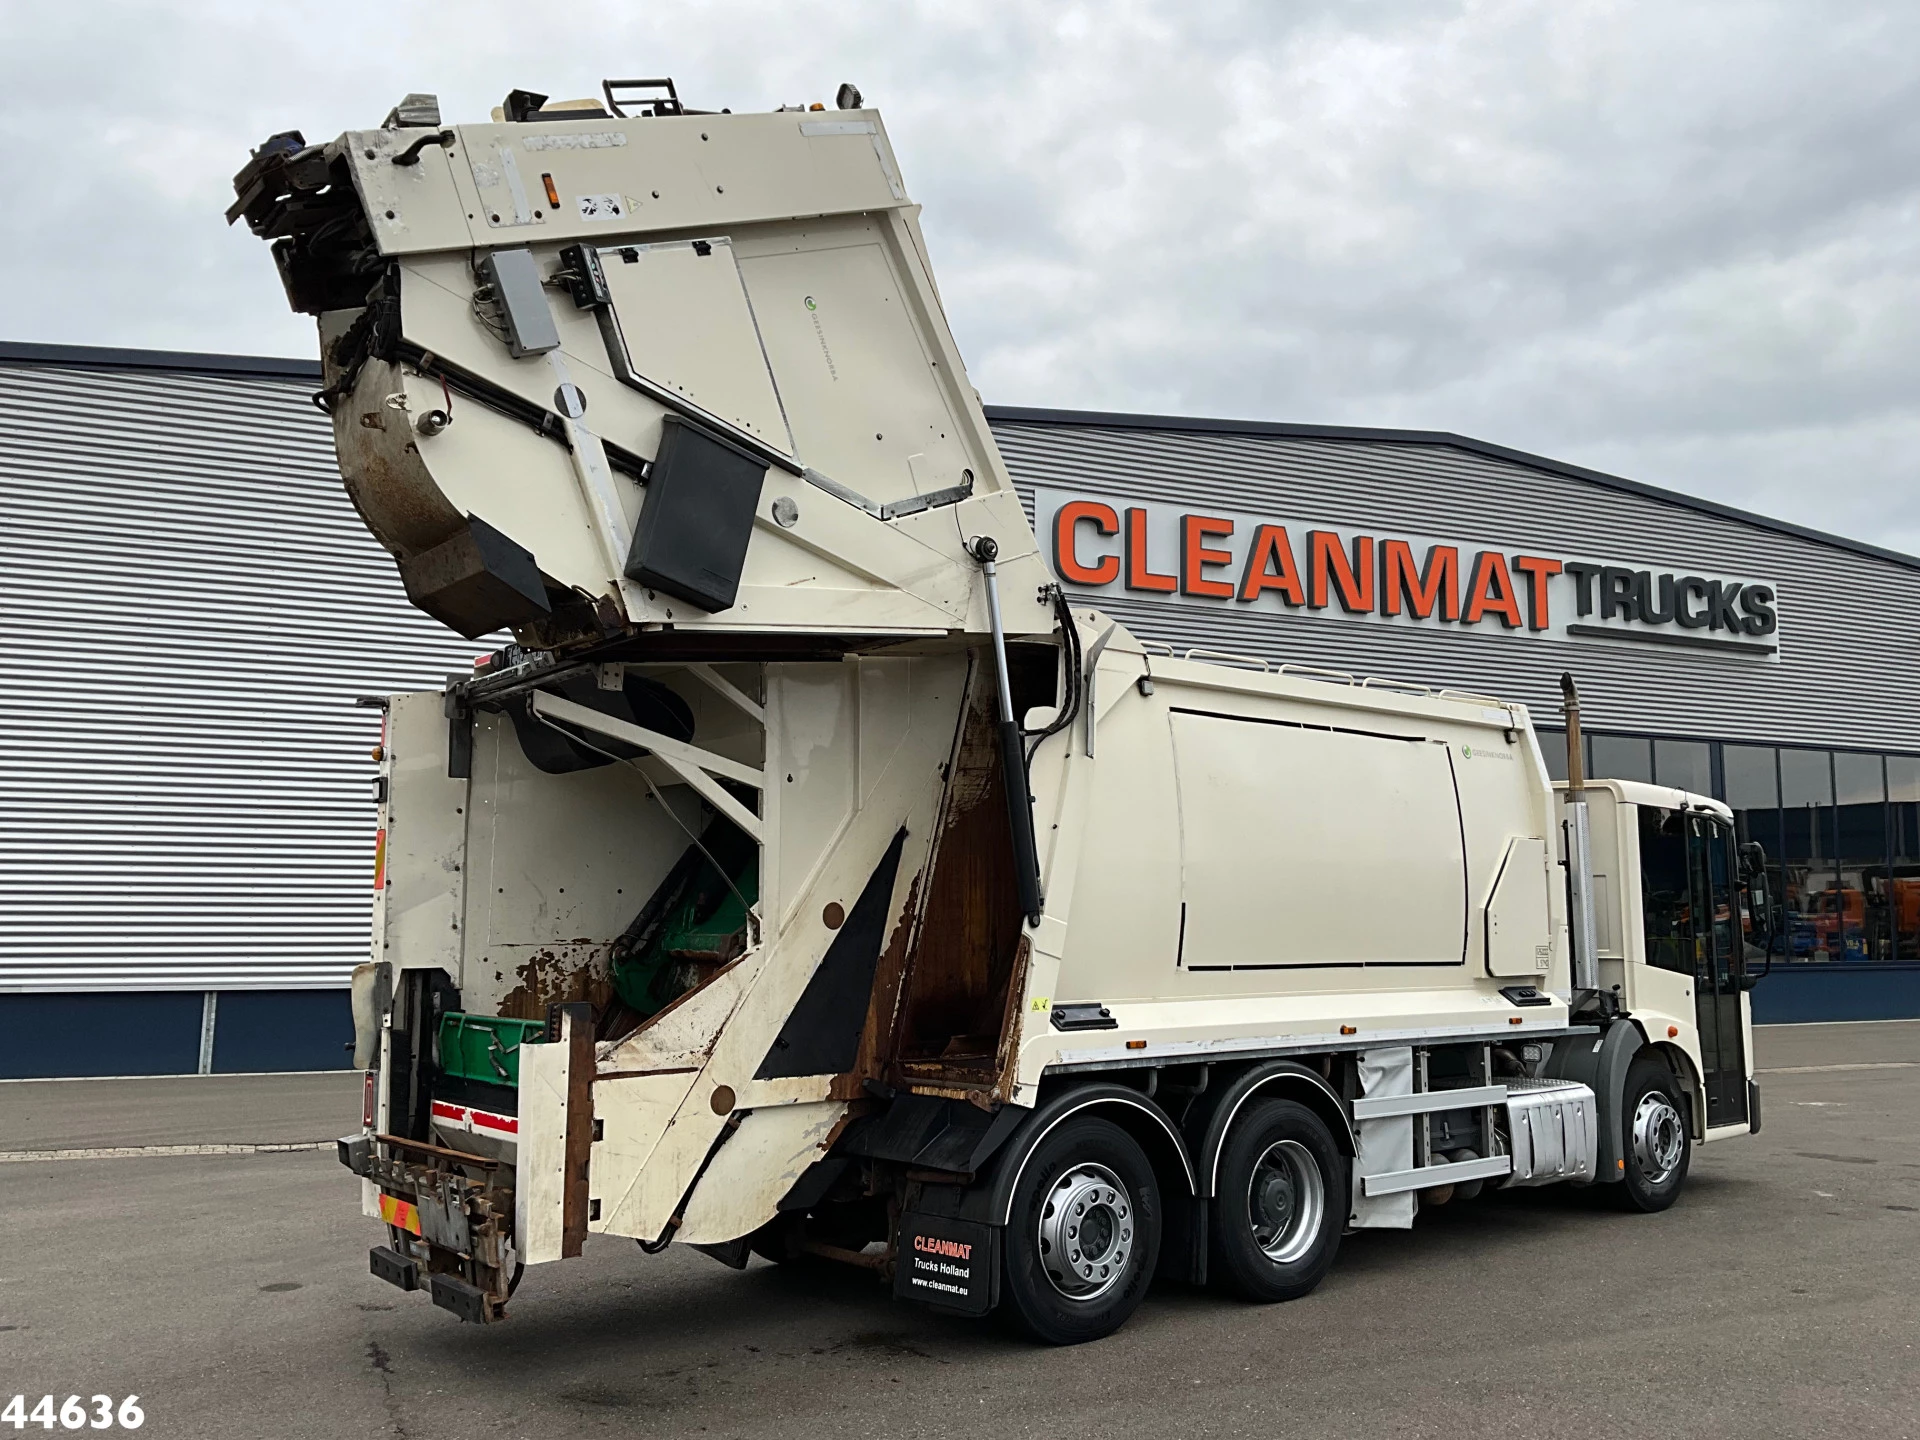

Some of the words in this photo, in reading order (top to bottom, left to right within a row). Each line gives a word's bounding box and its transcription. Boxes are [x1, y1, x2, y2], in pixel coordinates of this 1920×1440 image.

[811, 312, 839, 382] GEESINKNORBA
[1052, 500, 1563, 630] CLEANMAT
[1565, 561, 1777, 636] TRUCKS
[914, 1235, 972, 1260] CLEANMAT
[914, 1257, 939, 1273] Trucks
[939, 1262, 970, 1279] Holland
[911, 1277, 969, 1296] www.cleanmat.eu
